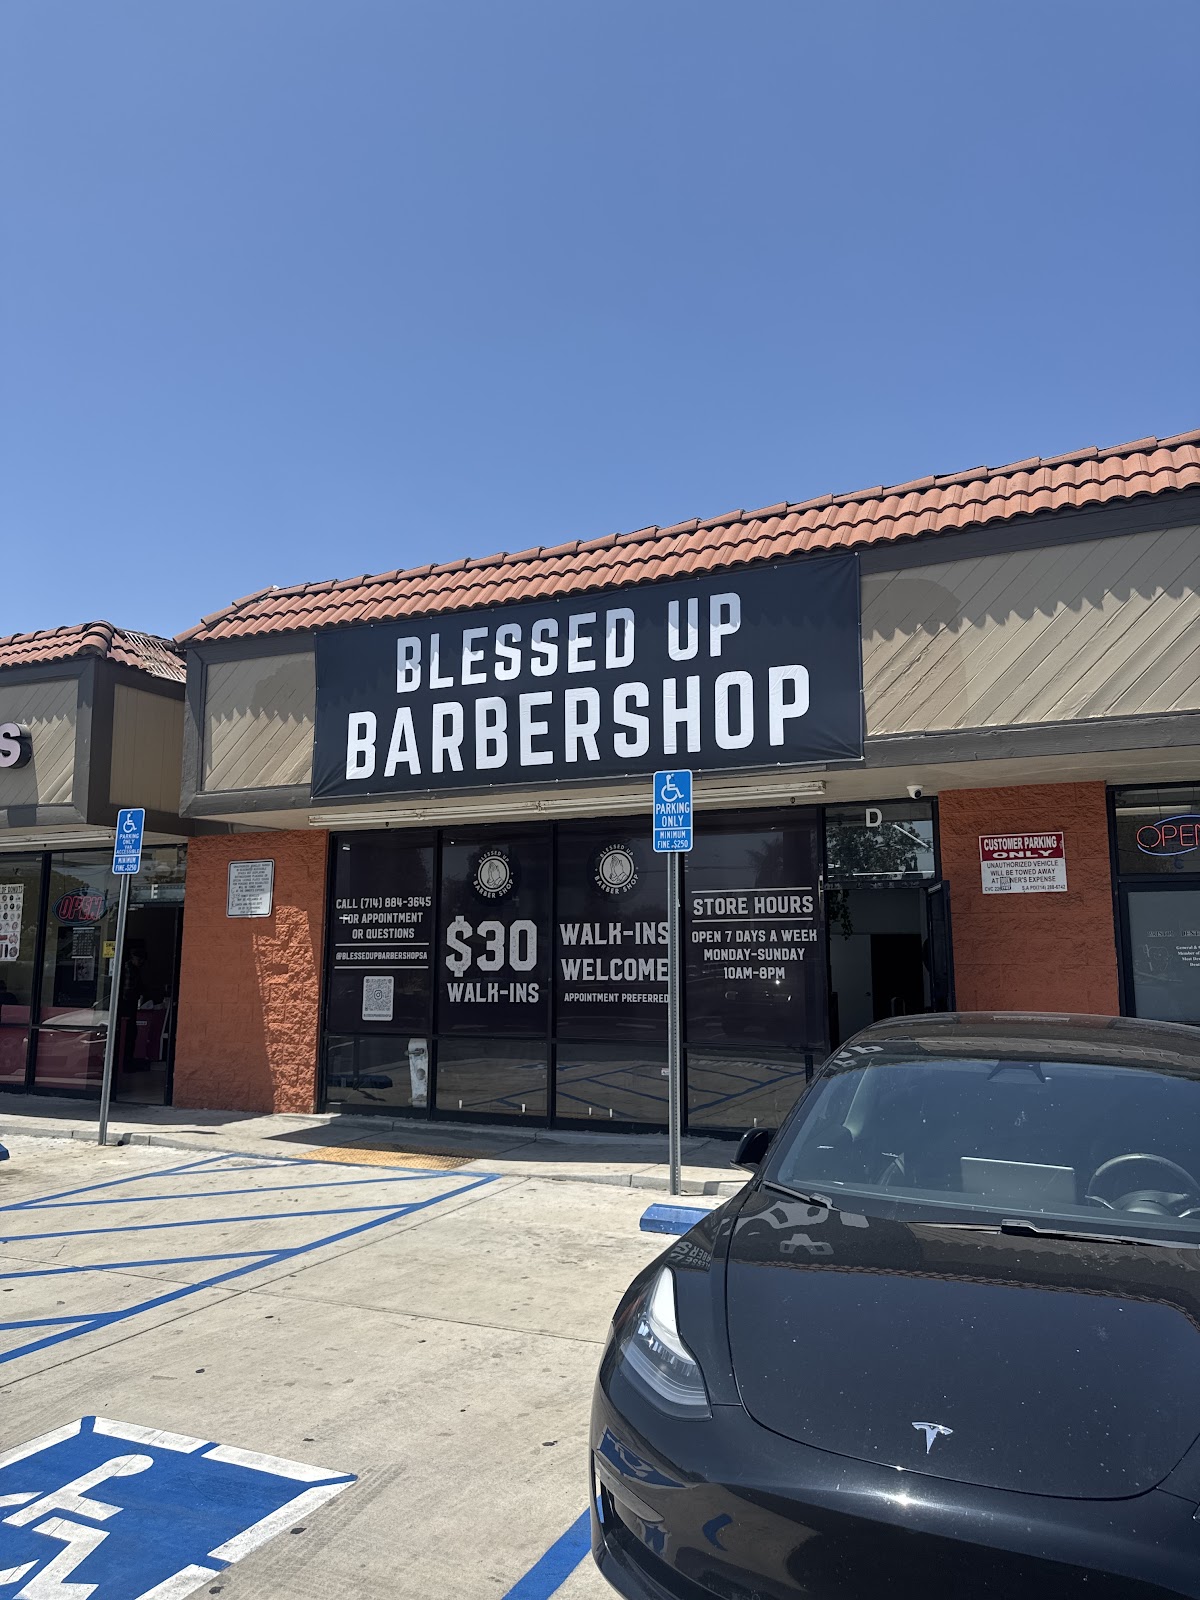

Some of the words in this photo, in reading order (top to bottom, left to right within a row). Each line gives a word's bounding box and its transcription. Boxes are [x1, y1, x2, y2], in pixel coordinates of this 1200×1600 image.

[397, 607, 635, 693] BLESSED
[668, 592, 741, 661] UP
[346, 664, 809, 780] BARBERSHOP
[656, 802, 690, 815] PARKING
[661, 815, 684, 828] ONLY
[865, 808, 883, 828] D
[660, 830, 686, 839] MINIMUM
[657, 840, 670, 849] FINE
[673, 839, 688, 849] $250
[984, 837, 1023, 850] CUSTOMER
[1024, 836, 1057, 848] PARKING
[478, 850, 502, 864] BLESSED
[599, 844, 625, 858] BLESSED
[993, 850, 1053, 858] ONLY
[986, 860, 1032, 869] UNAUTHORIZED
[1033, 859, 1059, 867] VEHICLE
[1015, 868, 1037, 876] TOWED
[594, 875, 620, 895] BARBER
[622, 873, 639, 893] SHOP
[1028, 875, 1056, 883] EXPENSE
[472, 880, 497, 899] BARBER
[498, 878, 514, 897] SHOP
[59, 895, 103, 921] OPEN
[336, 898, 358, 909] CALL
[360, 897, 383, 909] (714)
[384, 896, 432, 908] 884-3645
[693, 897, 749, 916] STORE
[754, 895, 814, 914] HOURS
[342, 913, 359, 924] FOR
[361, 911, 423, 923] APPOINTMENT
[352, 928, 364, 939] OR
[366, 927, 415, 939] QUESTIONS
[559, 921, 668, 945] WALK-INS
[691, 930, 722, 943] OPEN
[724, 930, 733, 942] 7
[735, 929, 766, 942] DAYS
[769, 930, 778, 942] A
[781, 929, 818, 942] WEEK
[445, 915, 538, 978] $30
[335, 951, 428, 960] @BLESSEDUPBARBERSHOPSA
[703, 948, 806, 961] MONDAY-SUNDAY
[561, 958, 669, 981] WELCOME
[723, 967, 785, 979] 10AM-8PM
[446, 982, 540, 1003] WALK-INS
[564, 992, 619, 1002] APPOINTMENT
[621, 993, 668, 1003] PREFERRED
